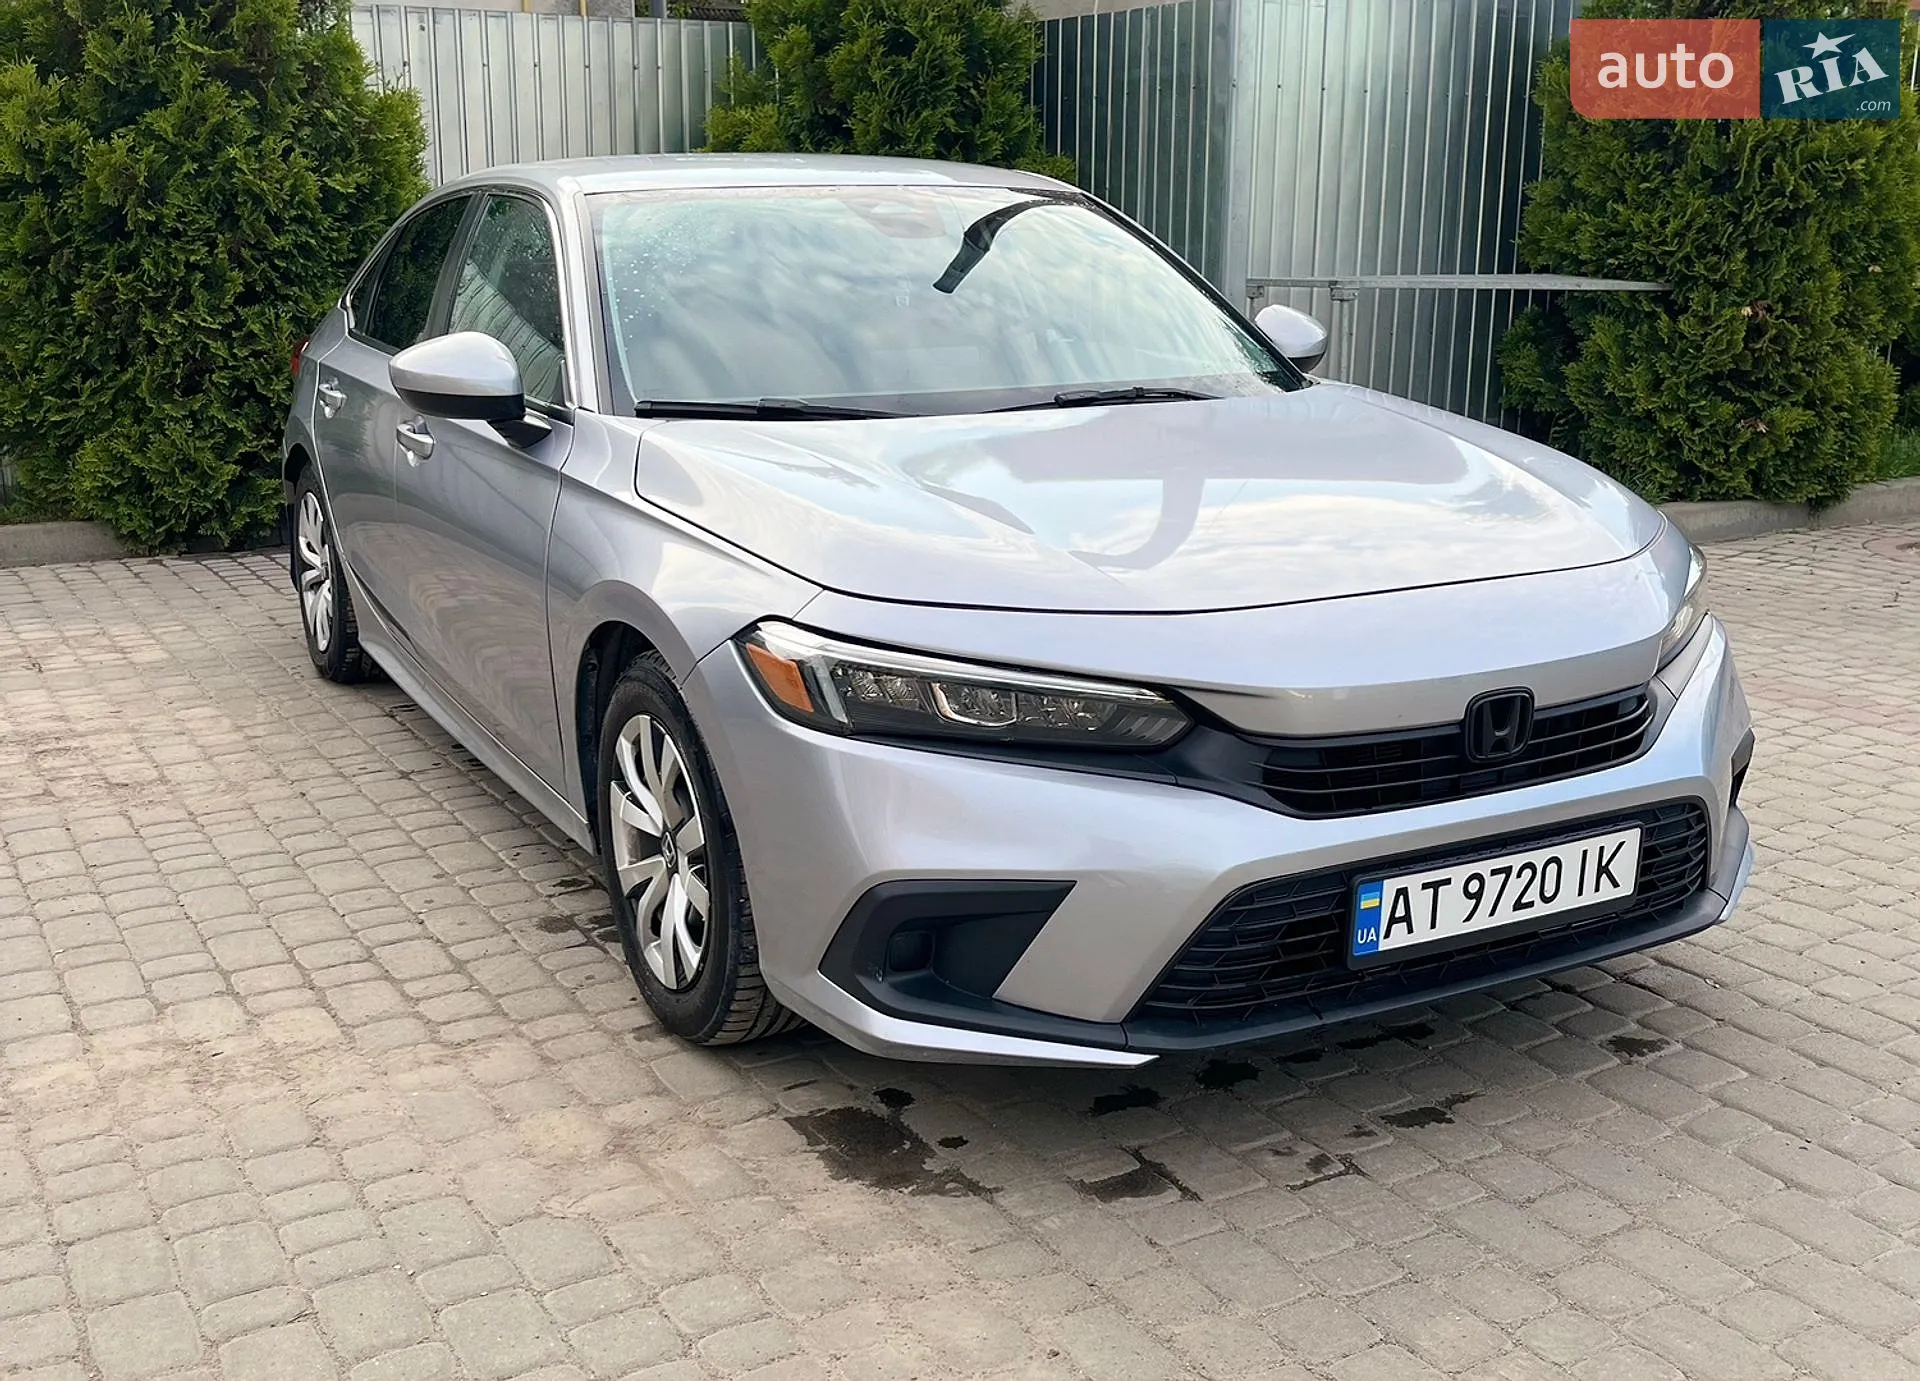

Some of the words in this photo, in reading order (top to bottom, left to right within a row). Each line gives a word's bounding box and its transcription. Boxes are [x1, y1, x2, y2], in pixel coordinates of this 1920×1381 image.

[1383, 877, 1452, 940] AT
[1462, 855, 1563, 923] 9720
[1577, 840, 1626, 897] IK
[1357, 927, 1377, 944] UA
